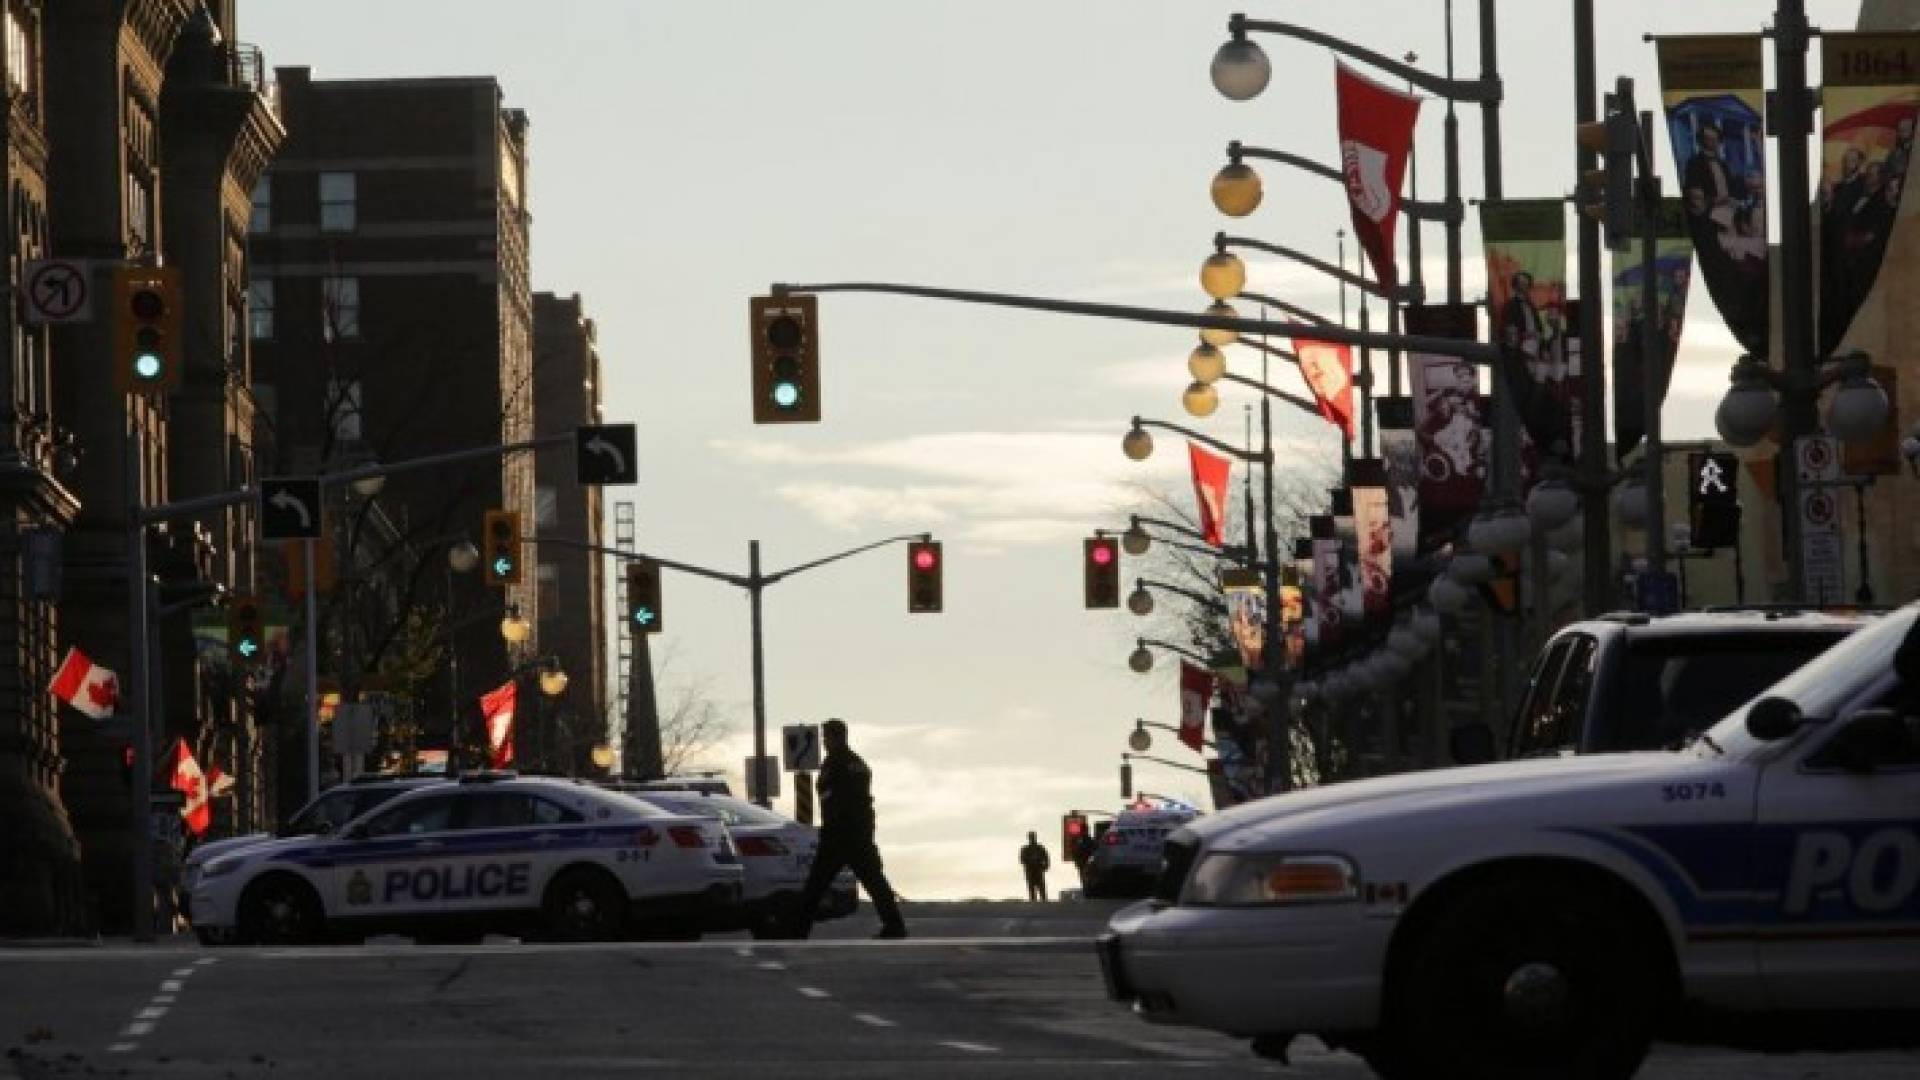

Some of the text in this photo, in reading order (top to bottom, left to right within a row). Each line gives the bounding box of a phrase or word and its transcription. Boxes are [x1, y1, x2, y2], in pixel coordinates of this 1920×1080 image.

[1662, 782, 1725, 801] 3074
[384, 863, 530, 901] POLICE
[1783, 827, 1920, 913] PO
